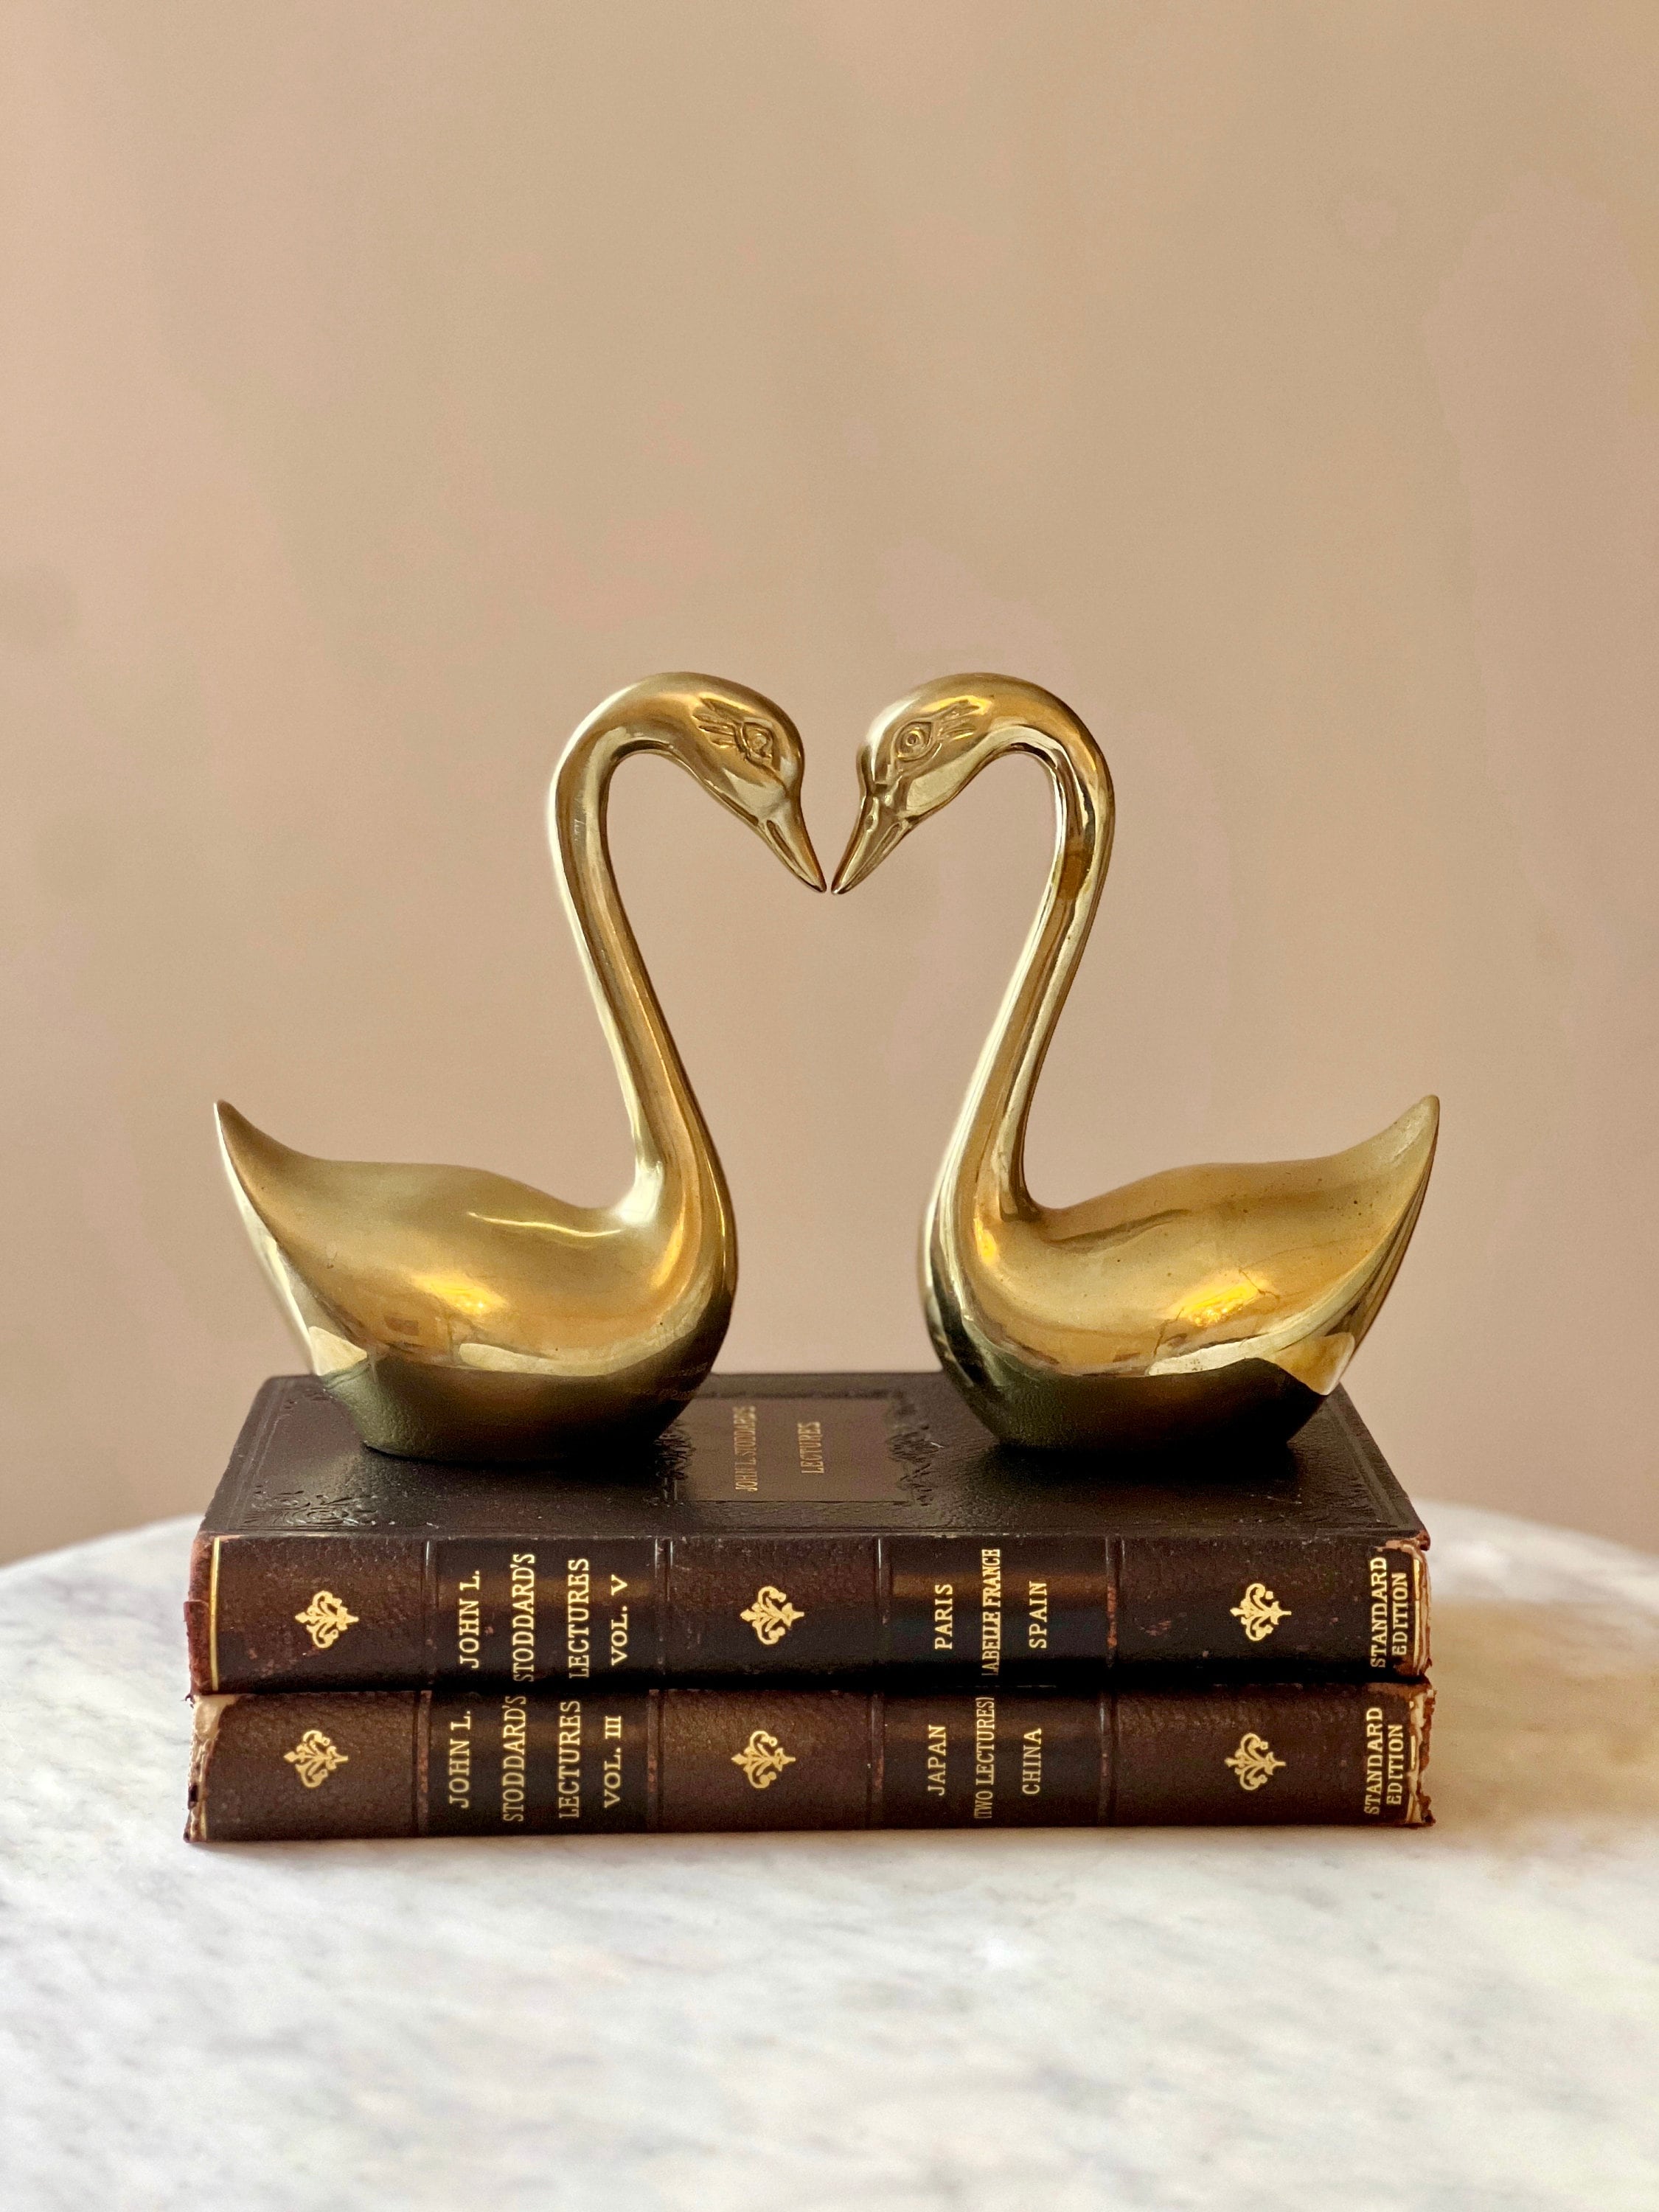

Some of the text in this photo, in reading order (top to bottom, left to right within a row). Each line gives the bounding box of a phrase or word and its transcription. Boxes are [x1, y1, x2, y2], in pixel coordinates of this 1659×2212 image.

[797, 1421, 824, 1474] LECTURES
[459, 1570, 480, 1669] JOHN L.
[510, 1553, 535, 1682] STODDARD'S
[568, 1557, 589, 1679] LECTURES
[611, 1574, 628, 1666] VOL. V
[934, 1584, 953, 1650] PARIS
[981, 1548, 1001, 1608] FRANCE
[1029, 1581, 1048, 1649] SPAIN
[1370, 1557, 1388, 1669] STANDARD
[1391, 1573, 1408, 1657] EDITION
[449, 1711, 471, 1809] JOHN L.
[502, 1695, 527, 1822] STODDARD'S
[558, 1700, 581, 1819] LECTURES
[604, 1716, 622, 1809] VOL. III
[928, 1725, 947, 1796] JAPAN
[975, 1697, 995, 1786] LECTURES)
[1022, 1728, 1042, 1795] CHINA
[1364, 1707, 1383, 1815] STANDARD
[1386, 1724, 1404, 1806] EDITION
